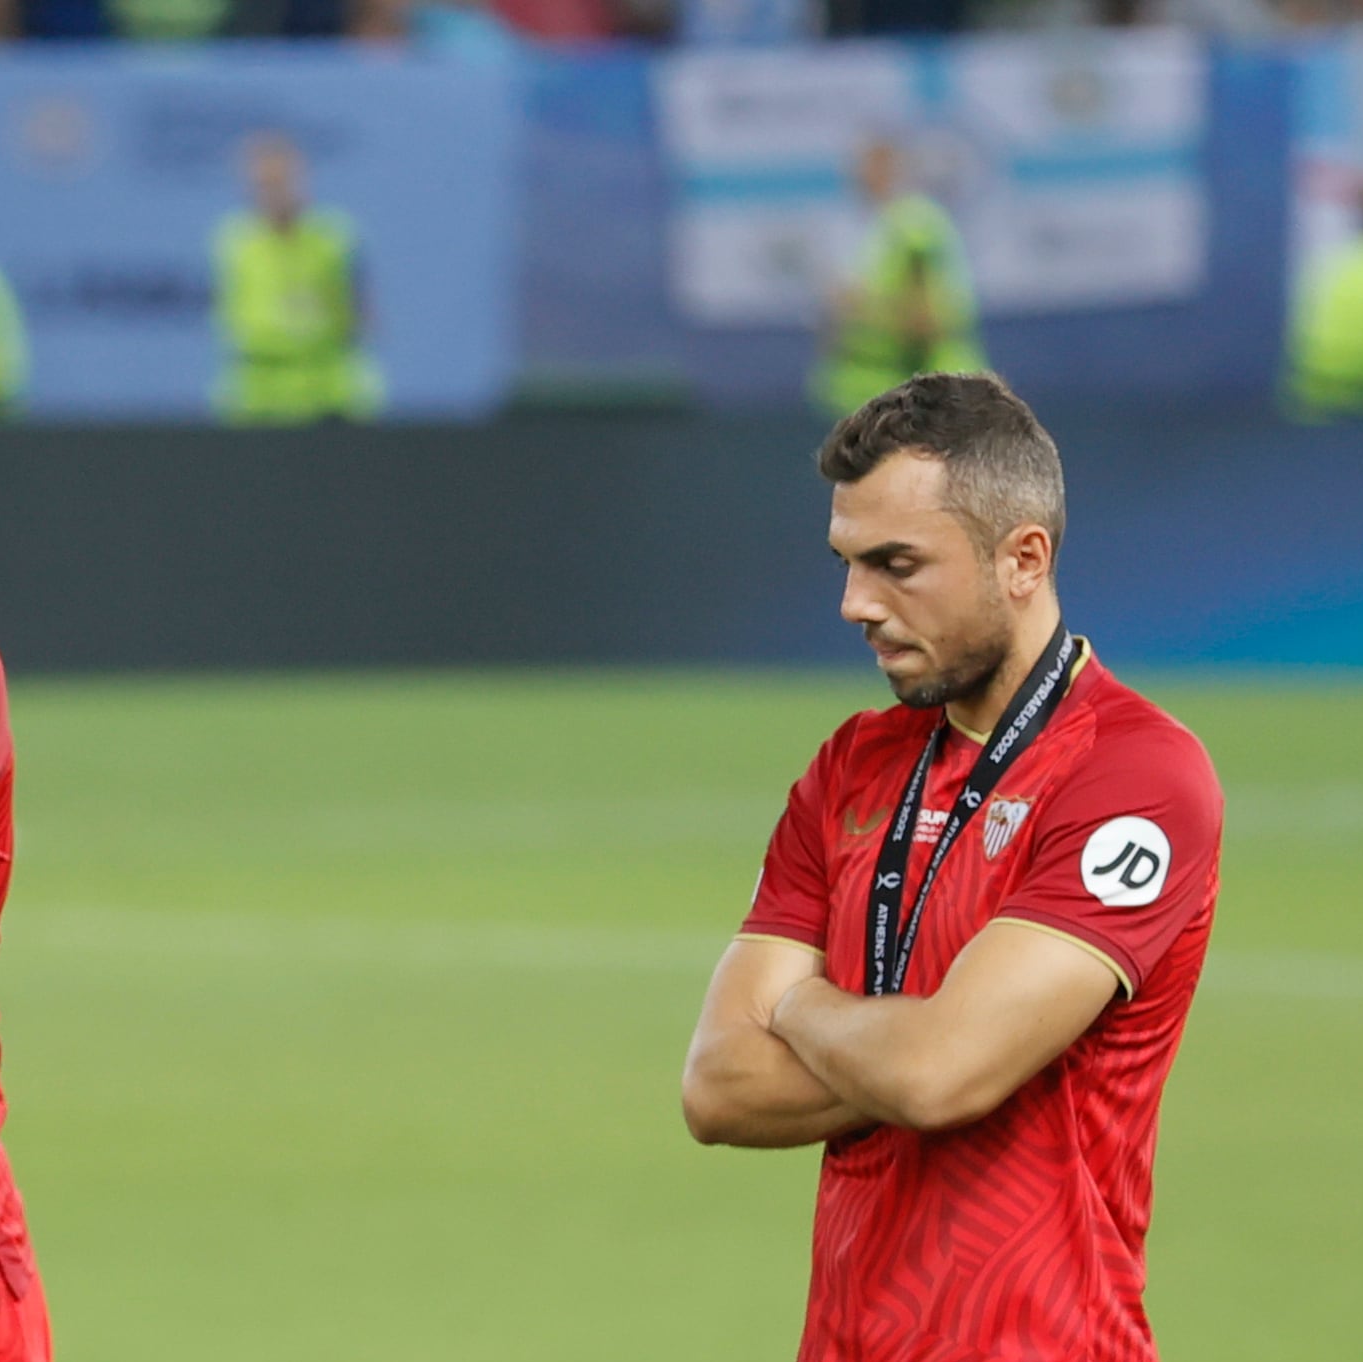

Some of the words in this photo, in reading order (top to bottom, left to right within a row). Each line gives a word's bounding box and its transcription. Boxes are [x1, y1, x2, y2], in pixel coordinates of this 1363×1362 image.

[1011, 675, 1056, 730] PIRAEUS
[987, 725, 1020, 763] 2023
[930, 816, 961, 868] ATHENS
[1092, 842, 1160, 889] JD
[872, 902, 889, 959] ATHENS
